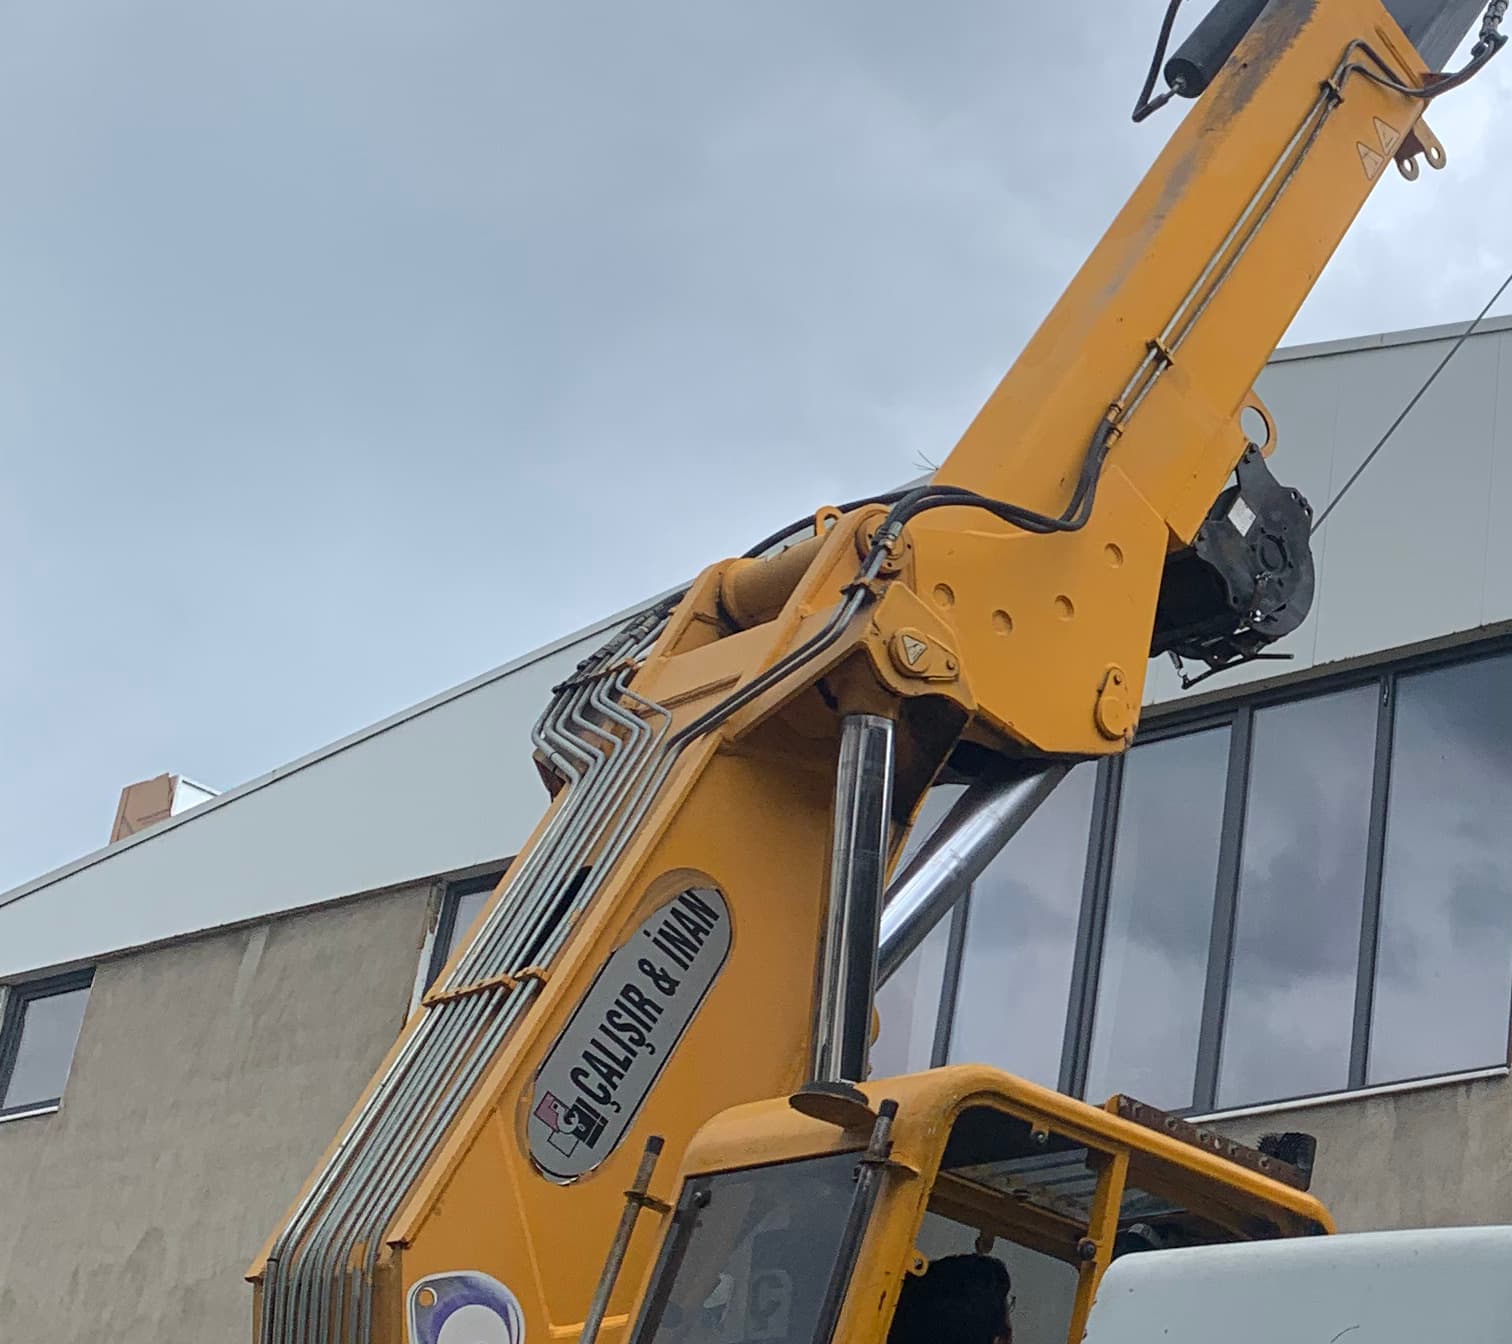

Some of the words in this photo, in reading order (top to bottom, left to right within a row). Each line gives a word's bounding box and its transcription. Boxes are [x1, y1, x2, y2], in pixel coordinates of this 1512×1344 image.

[643, 889, 720, 971] İNAN
[637, 958, 680, 997] &
[570, 983, 664, 1112] ÇALIŞIR
